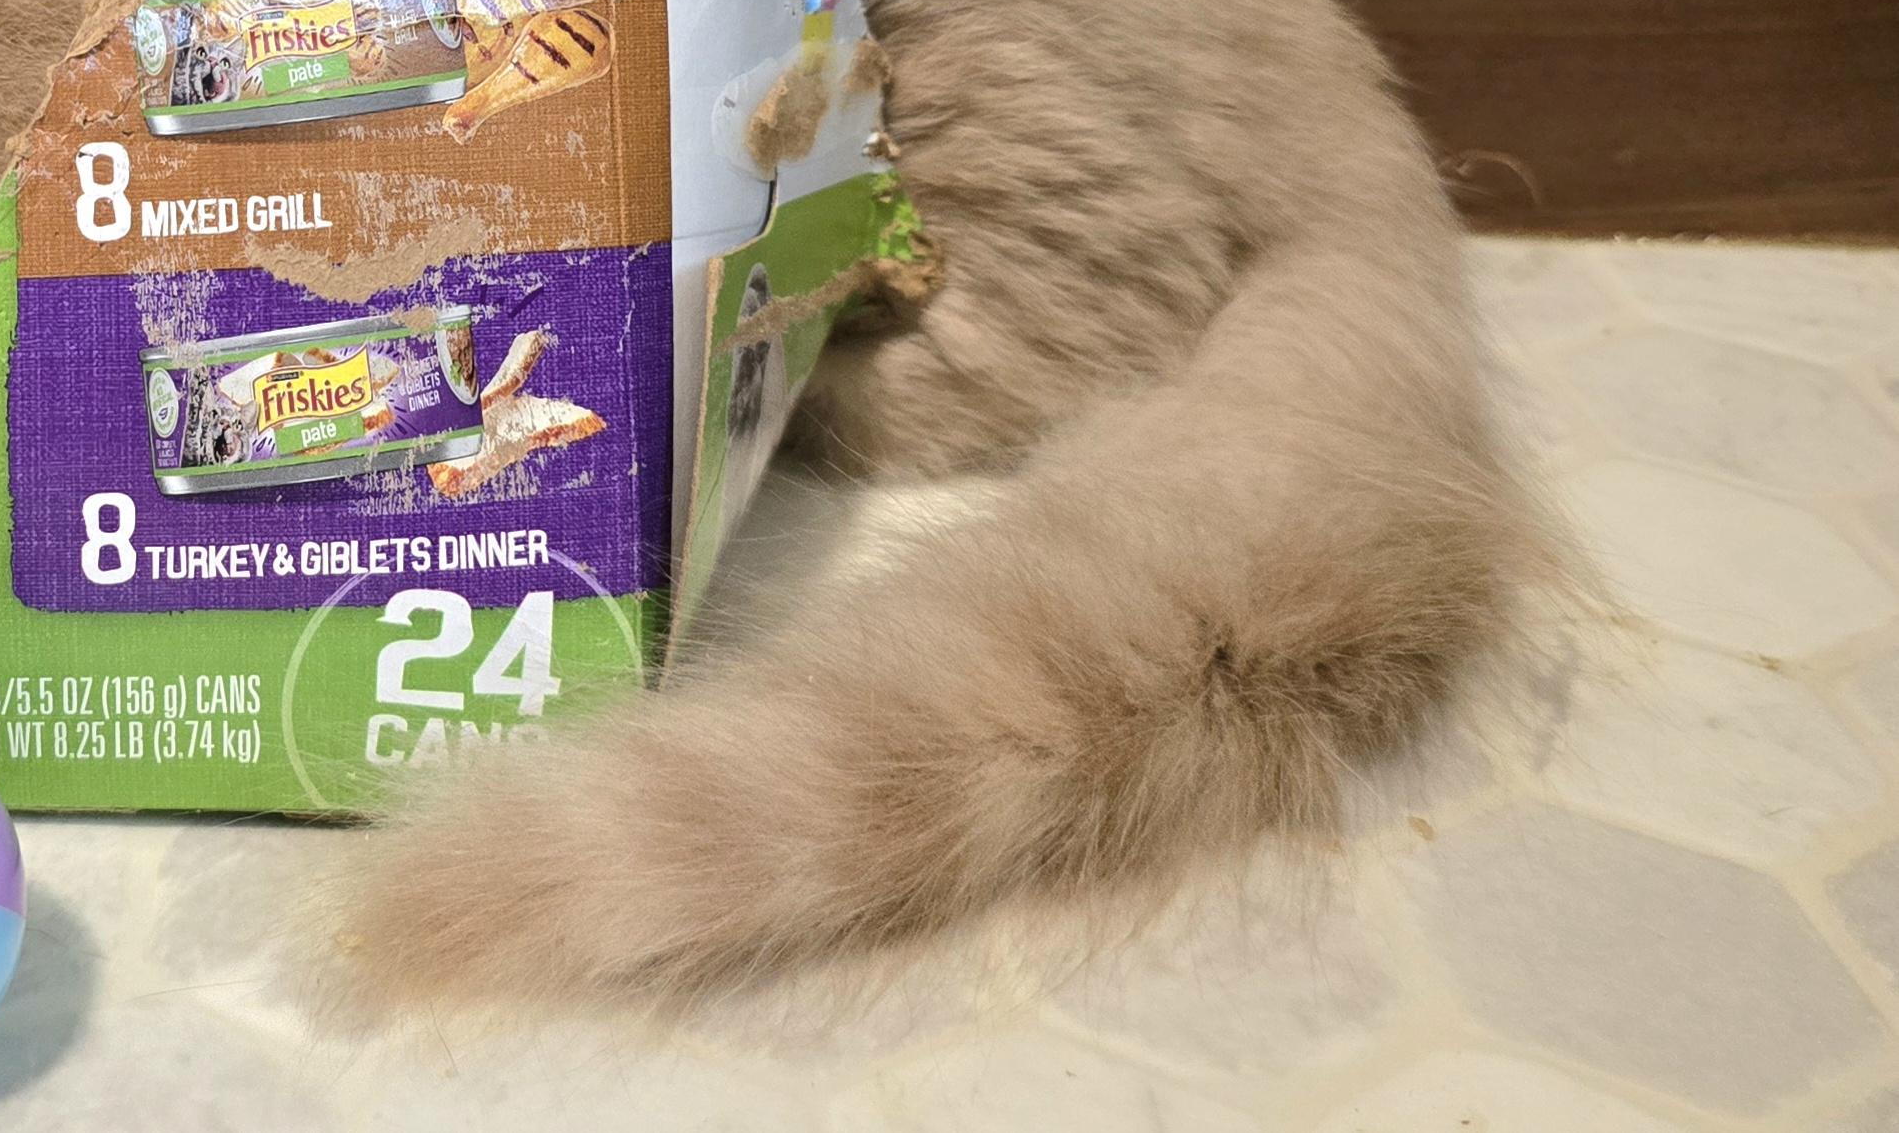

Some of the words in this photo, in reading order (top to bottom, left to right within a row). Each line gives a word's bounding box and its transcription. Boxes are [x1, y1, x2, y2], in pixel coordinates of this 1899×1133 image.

[249, 17, 351, 61] Friskies
[75, 142, 132, 242] 8
[141, 198, 239, 237] MIXED
[246, 192, 333, 233] GRILL
[262, 378, 365, 423] Friskies
[409, 390, 441, 412] DINNER
[81, 492, 136, 585] 8
[144, 543, 269, 580] TURKEY
[273, 543, 296, 576] &
[300, 535, 432, 575] GIBLETS
[438, 530, 549, 570] DINNER
[375, 589, 561, 717] 24
[63, 677, 93, 716] OZ
[101, 674, 154, 718] (156
[164, 674, 187, 719] g)
[196, 674, 262, 714] CANS
[7, 720, 44, 759] WT
[54, 720, 106, 759] 8.25
[115, 720, 143, 758] LB
[153, 719, 214, 763] (3.74
[223, 719, 261, 764] kg)
